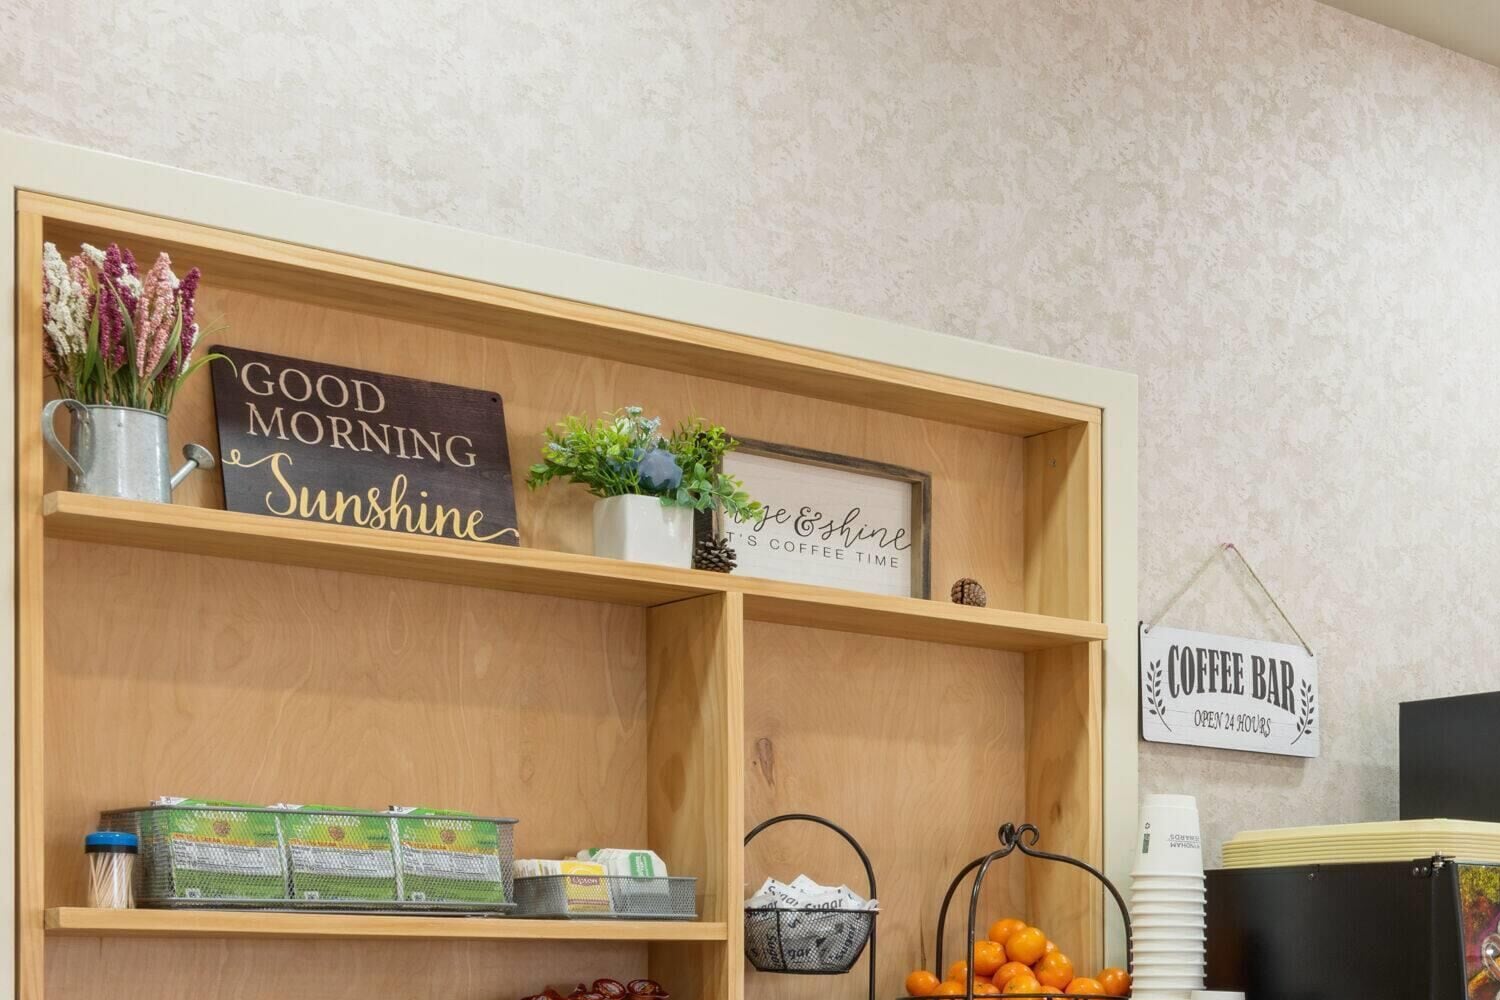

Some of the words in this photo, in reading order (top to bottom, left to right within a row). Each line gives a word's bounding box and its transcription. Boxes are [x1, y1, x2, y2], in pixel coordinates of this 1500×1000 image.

[241, 361, 385, 414] GOOD
[245, 401, 478, 468] MORNING
[222, 448, 519, 542] Sunshine
[725, 505, 791, 532] ise
[794, 506, 822, 537] &
[819, 507, 912, 550] shine
[726, 531, 757, 546] T'S
[769, 539, 844, 560] COFFEE
[856, 551, 899, 568] TIME
[1168, 644, 1244, 698] COFFEE
[1251, 655, 1296, 714] BAR
[1194, 709, 1224, 730] OPEN
[1225, 713, 1234, 732] 24
[1236, 713, 1271, 738] HOURS
[804, 898, 843, 915] Sugar
[787, 948, 811, 960] gar
